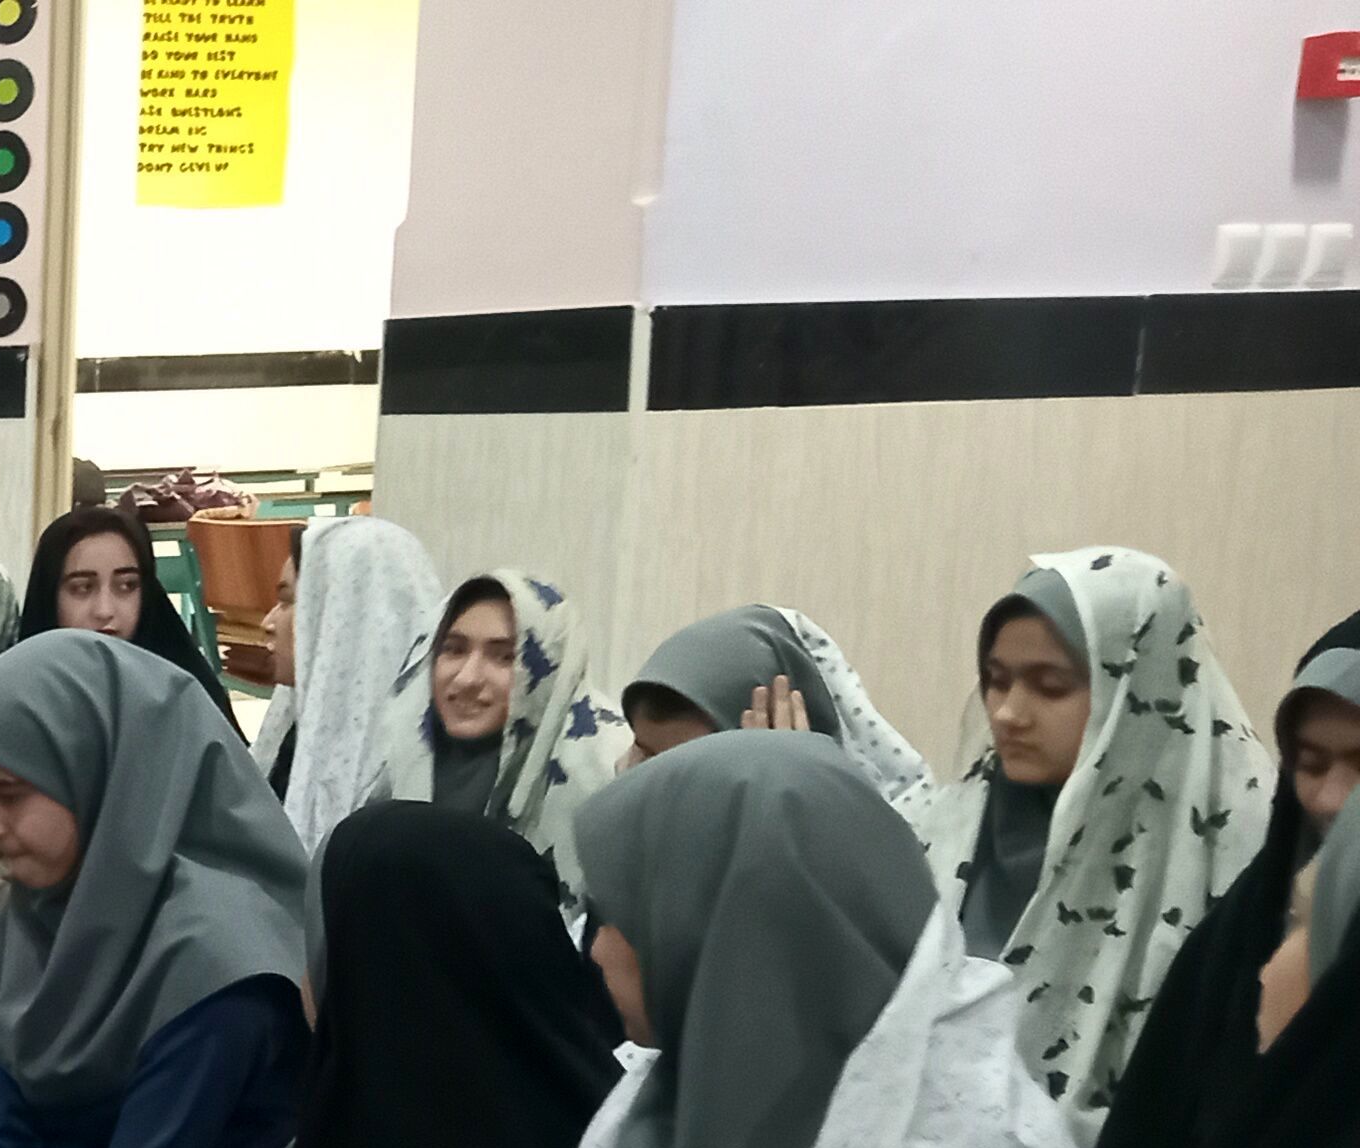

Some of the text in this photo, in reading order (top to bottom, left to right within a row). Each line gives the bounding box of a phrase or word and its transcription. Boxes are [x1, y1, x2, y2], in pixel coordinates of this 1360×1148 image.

[191, 69, 208, 81] TO
[139, 87, 175, 98] WORK
[138, 142, 165, 153] TRY
[171, 143, 199, 153] NEW
